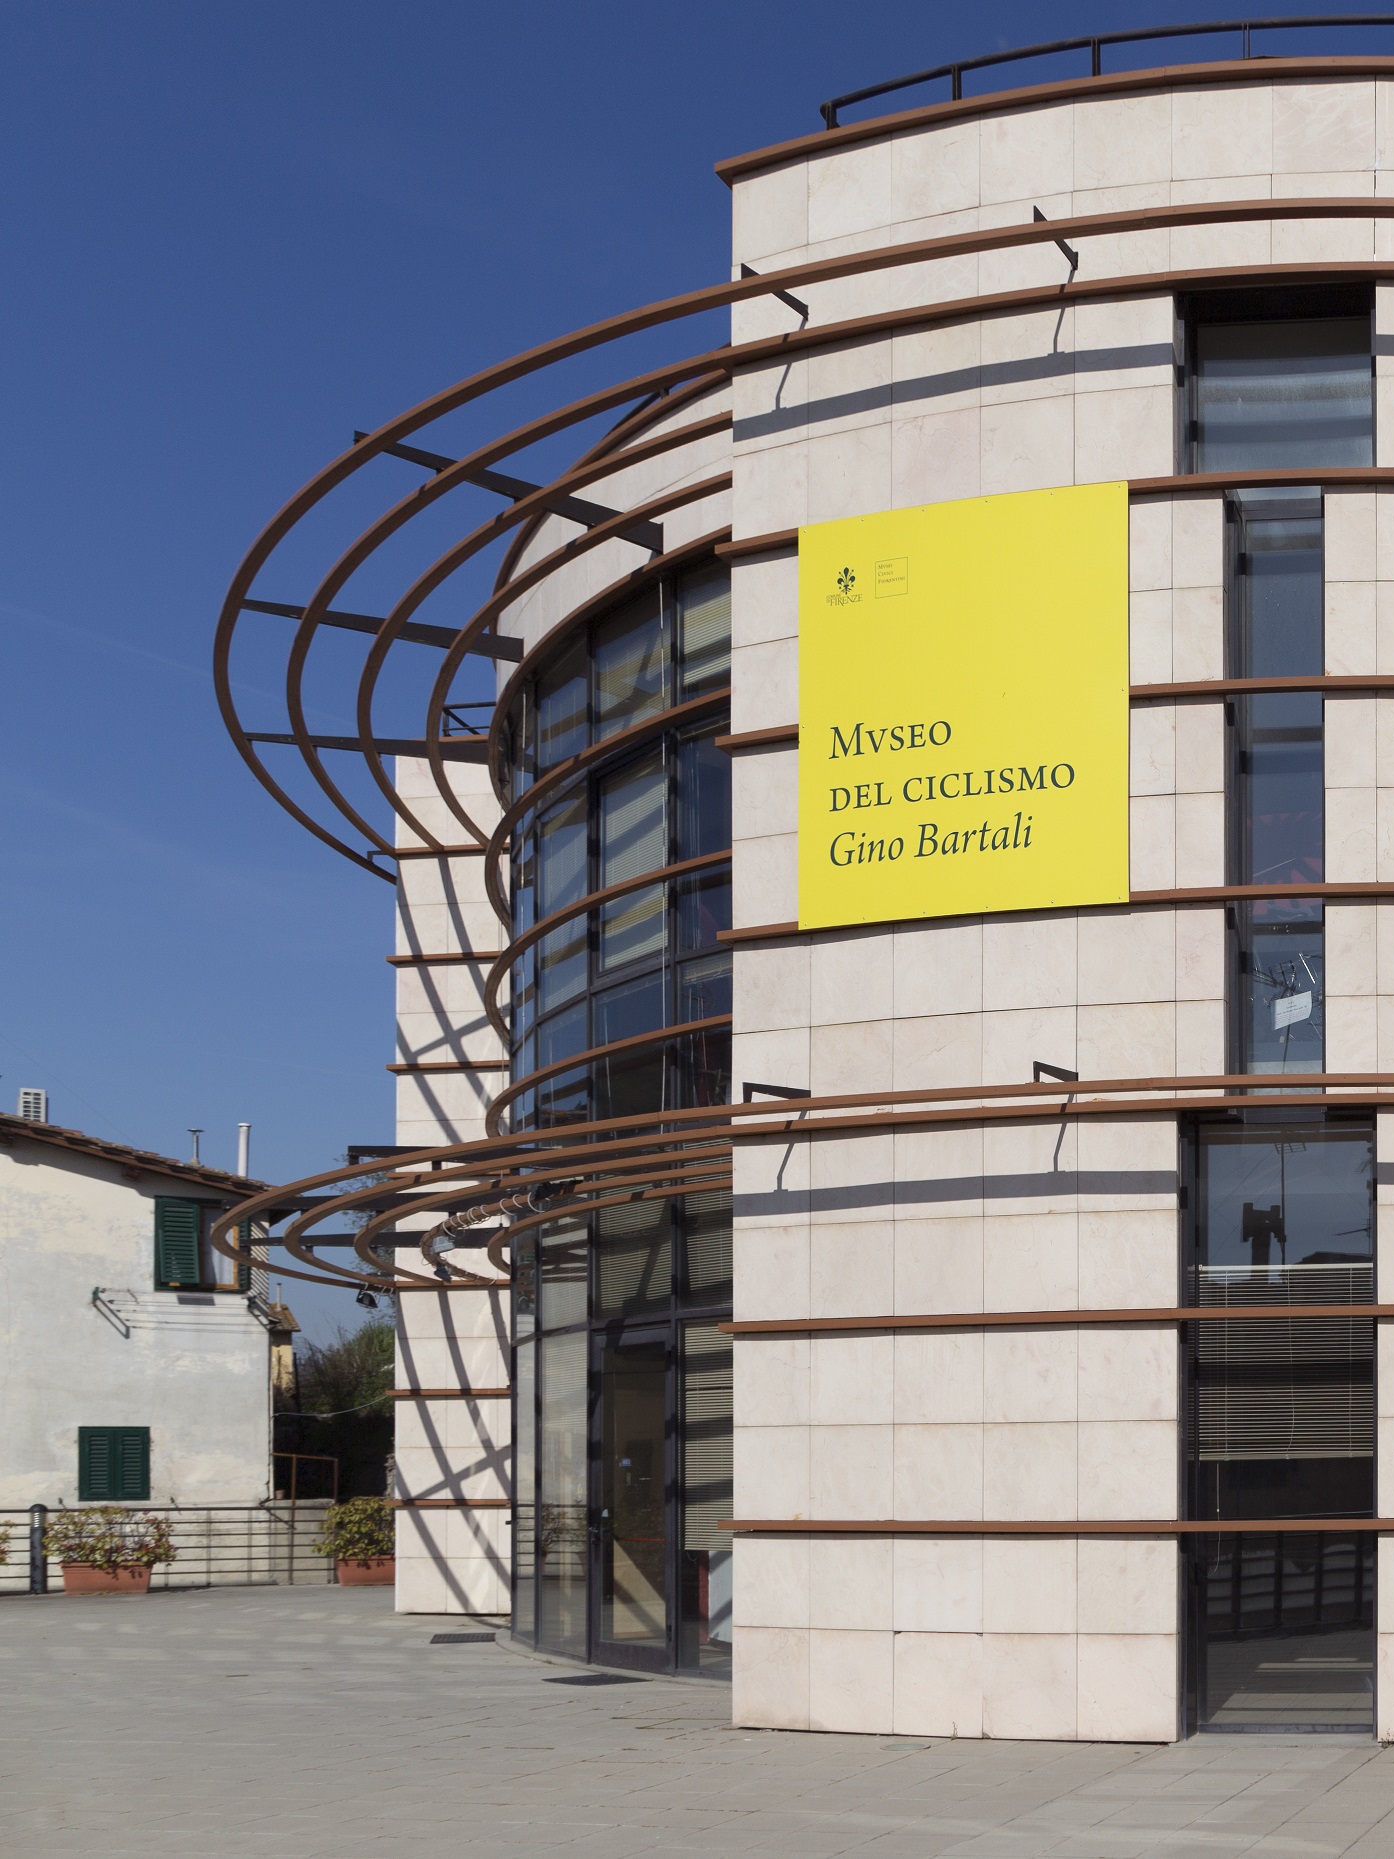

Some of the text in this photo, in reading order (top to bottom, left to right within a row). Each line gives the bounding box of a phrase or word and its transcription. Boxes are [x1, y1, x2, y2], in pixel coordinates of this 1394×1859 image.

[829, 763, 1075, 812] DEL CICLISMO
[829, 811, 1033, 867] Gino Bartali
